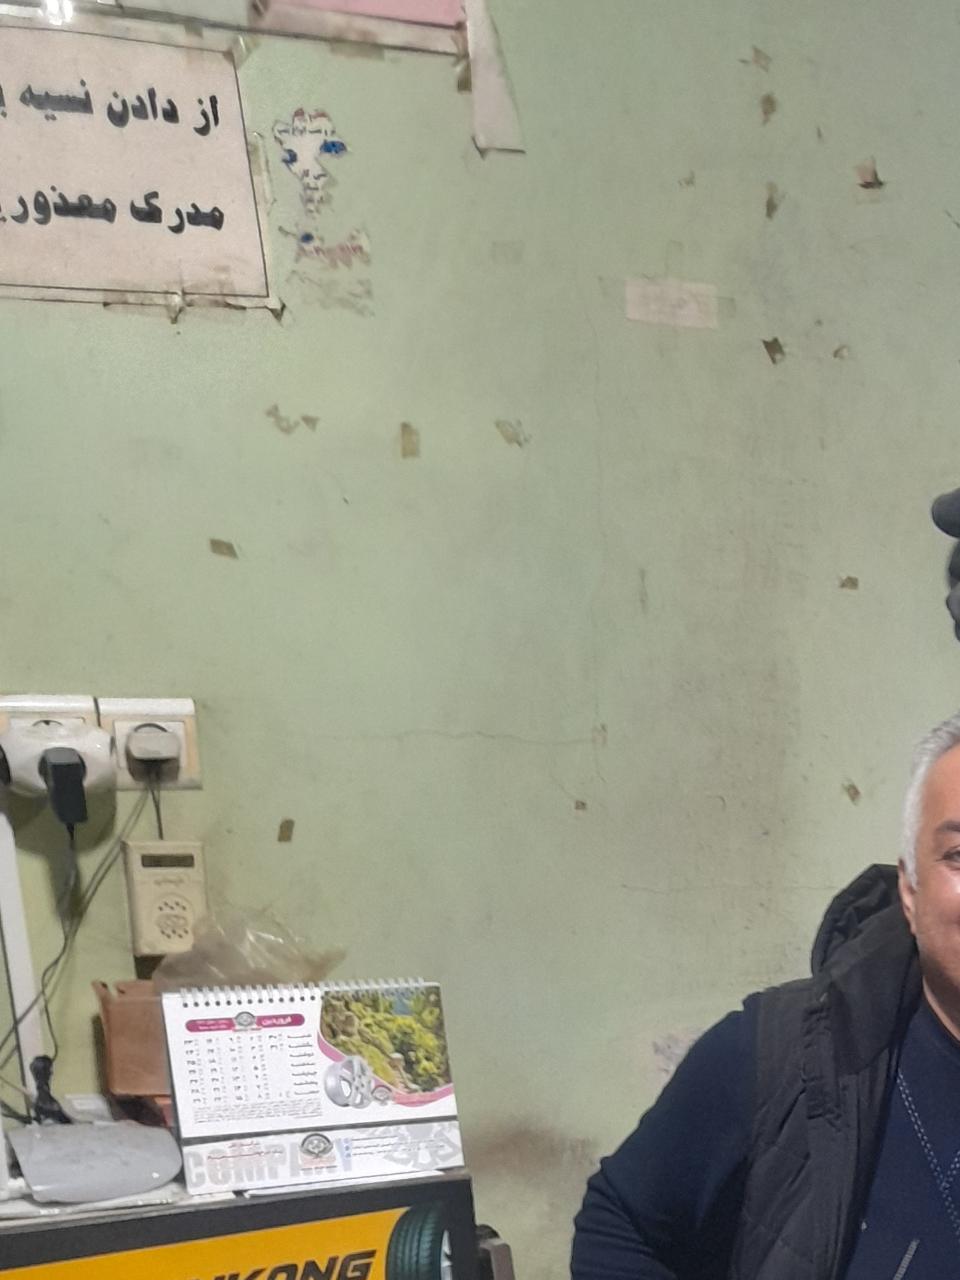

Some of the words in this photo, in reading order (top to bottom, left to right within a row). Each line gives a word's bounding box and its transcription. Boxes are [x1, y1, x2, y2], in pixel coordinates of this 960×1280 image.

[19, 79, 94, 121] نسیه
[106, 87, 180, 128] دادن
[193, 94, 220, 137] از
[0, 185, 117, 226] معذور
[129, 190, 225, 235] مدرک
